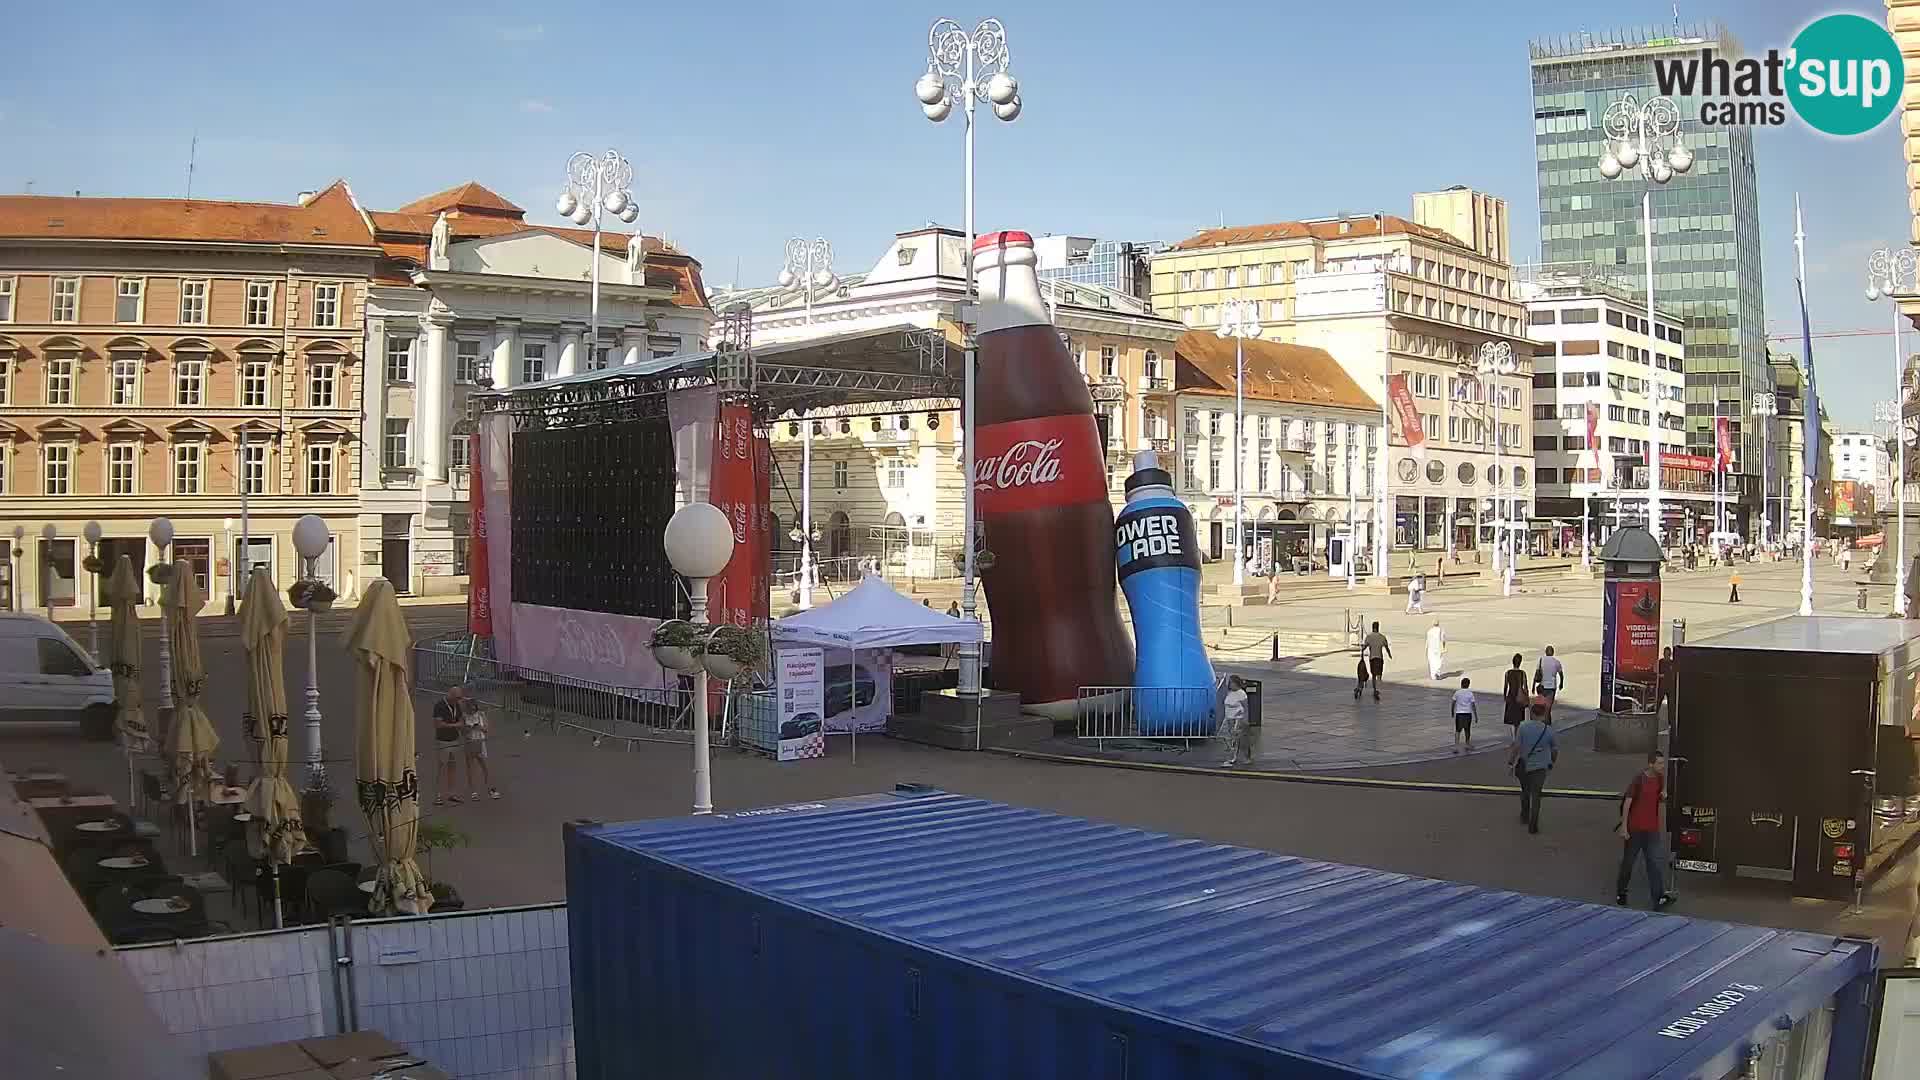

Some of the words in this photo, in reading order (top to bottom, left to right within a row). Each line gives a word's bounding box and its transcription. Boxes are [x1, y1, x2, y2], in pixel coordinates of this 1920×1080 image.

[735, 416, 747, 459] Coca-Cola
[974, 438, 1064, 489] ca-Cola
[735, 502, 746, 543] Coca-Cola
[1116, 515, 1179, 547] OWER
[1133, 535, 1182, 560] ADE
[1690, 990, 1747, 1019] 300629
